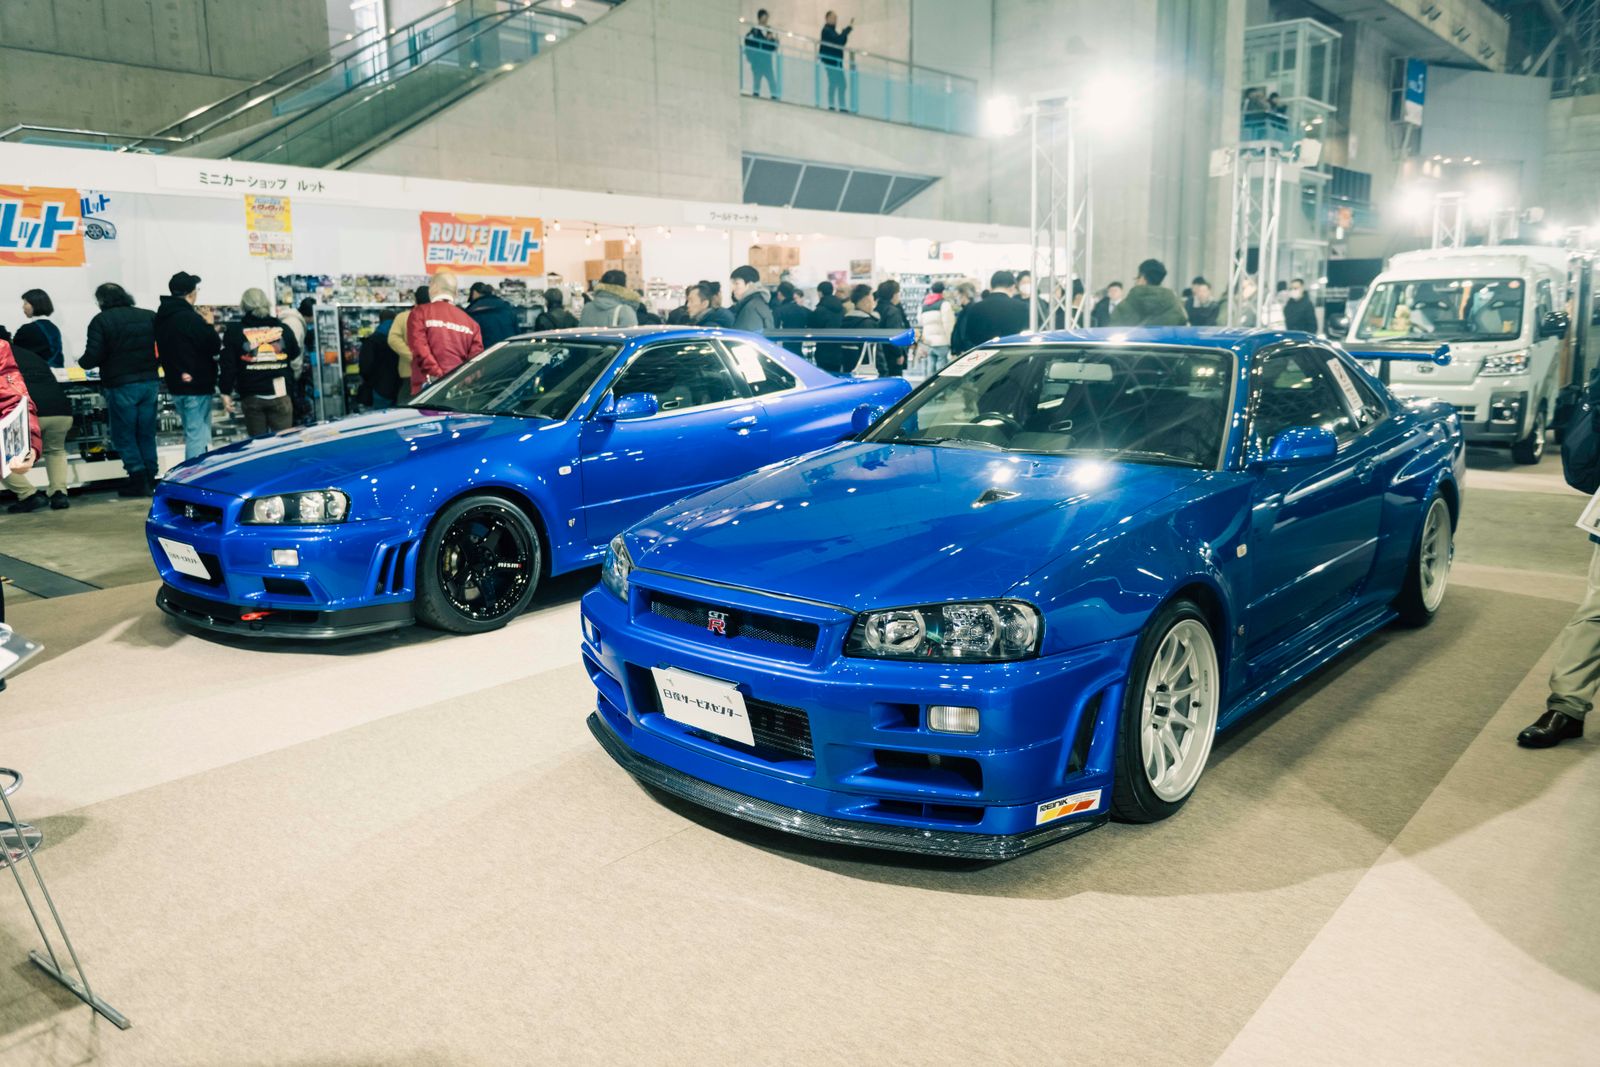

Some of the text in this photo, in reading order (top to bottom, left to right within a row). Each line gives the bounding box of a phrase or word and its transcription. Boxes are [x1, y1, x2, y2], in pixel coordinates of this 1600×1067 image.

[199, 171, 326, 193] ミニカーショップ ルット
[429, 222, 489, 245] ROUTE
[429, 246, 486, 262] ミニカーショップ
[488, 229, 539, 263] ルット
[663, 688, 743, 718] 日産サービスセンター
